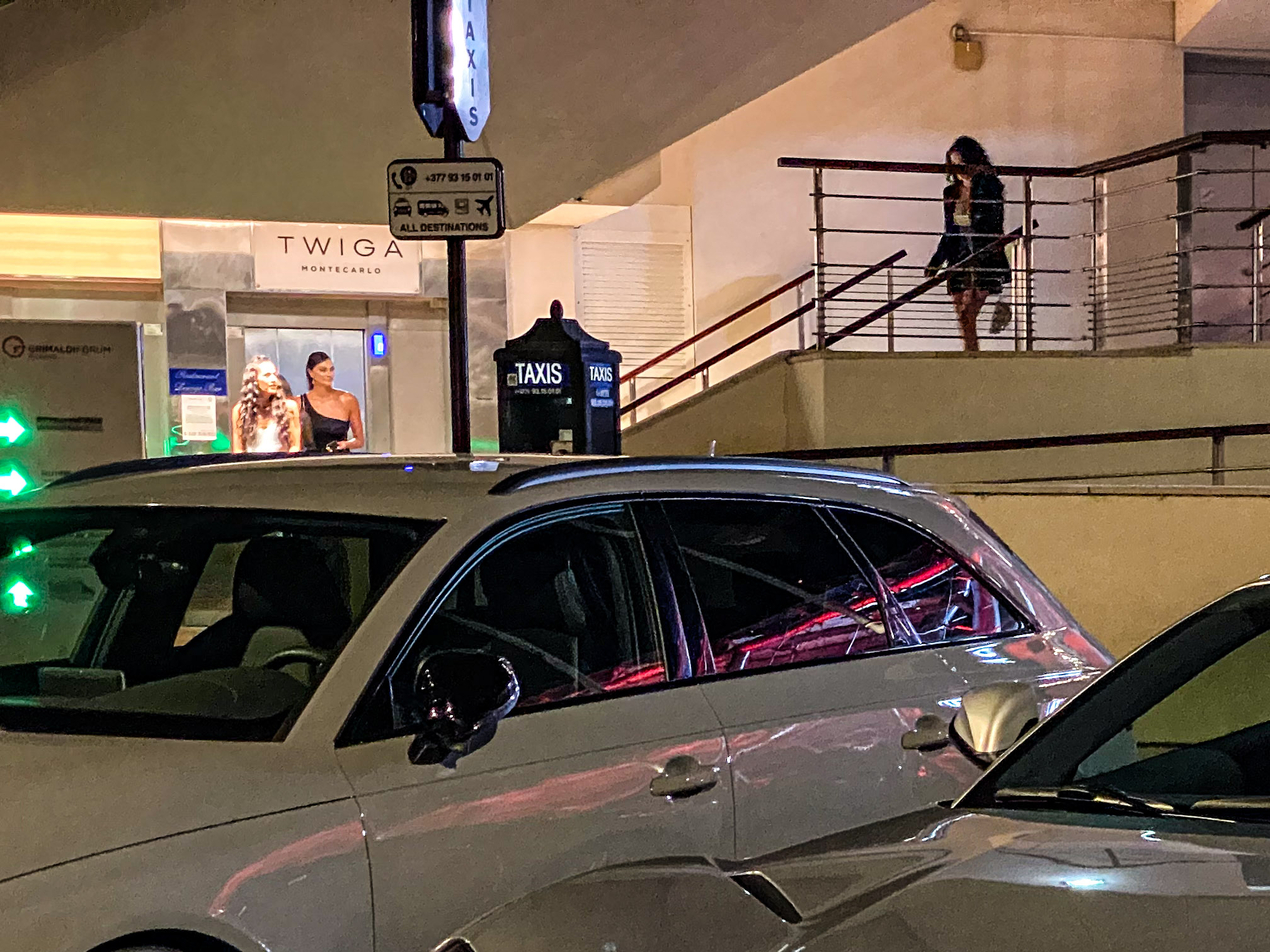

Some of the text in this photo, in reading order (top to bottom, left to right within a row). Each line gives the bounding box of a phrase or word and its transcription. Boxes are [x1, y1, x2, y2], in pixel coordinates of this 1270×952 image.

[425, 172, 494, 182] +377 93 15 01 01
[400, 222, 489, 232] ALL DESTINATIONS
[277, 236, 403, 258] TWIGA
[301, 265, 381, 274] MONTECARLO
[515, 362, 562, 384] TAXIS
[589, 366, 613, 382] TAXIS
